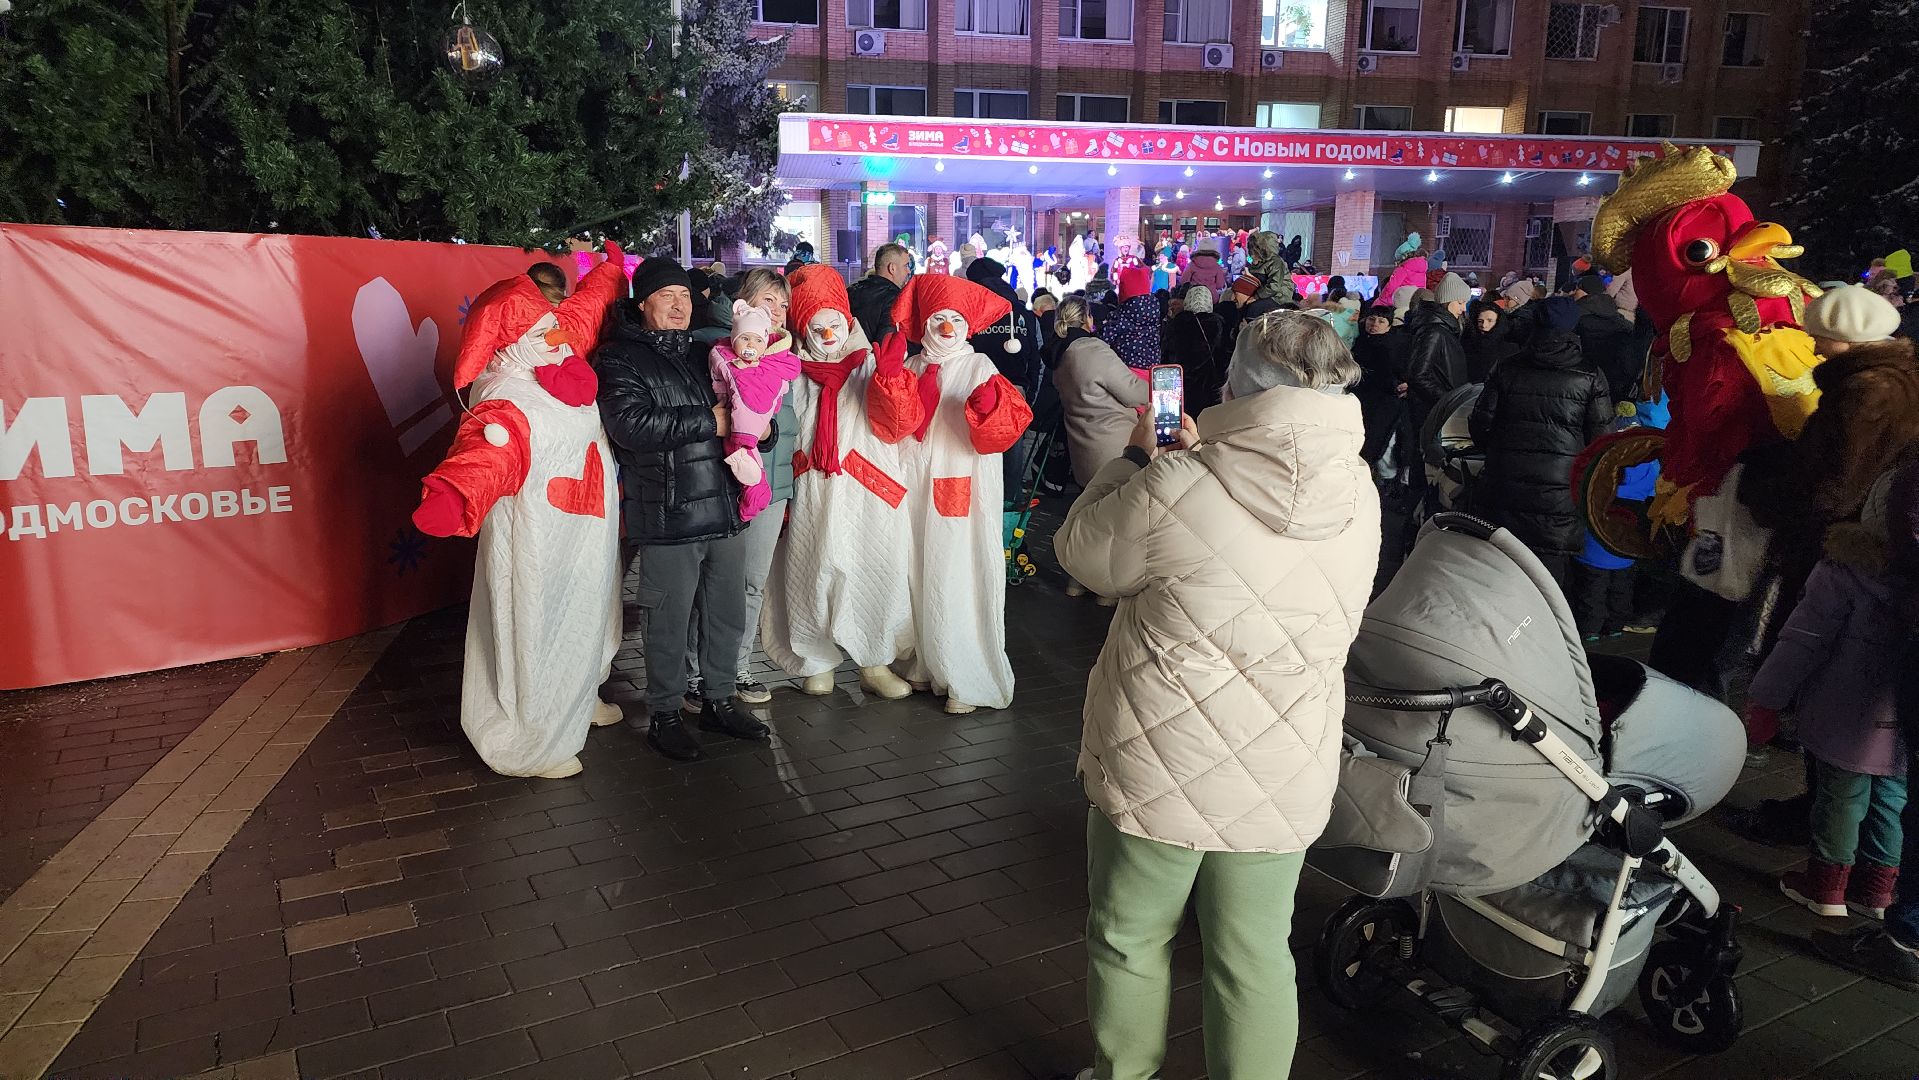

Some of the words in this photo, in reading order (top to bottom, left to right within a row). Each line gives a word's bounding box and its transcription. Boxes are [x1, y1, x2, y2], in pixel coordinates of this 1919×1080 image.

[908, 130, 944, 142] ЗИМА
[1213, 136, 1229, 156] С
[1233, 137, 1310, 159] Новым
[1315, 141, 1388, 162] годом!
[0, 486, 293, 541] ДМОСКОВЬЕ
[1507, 615, 1532, 646] nano
[1559, 750, 1584, 775] nano
